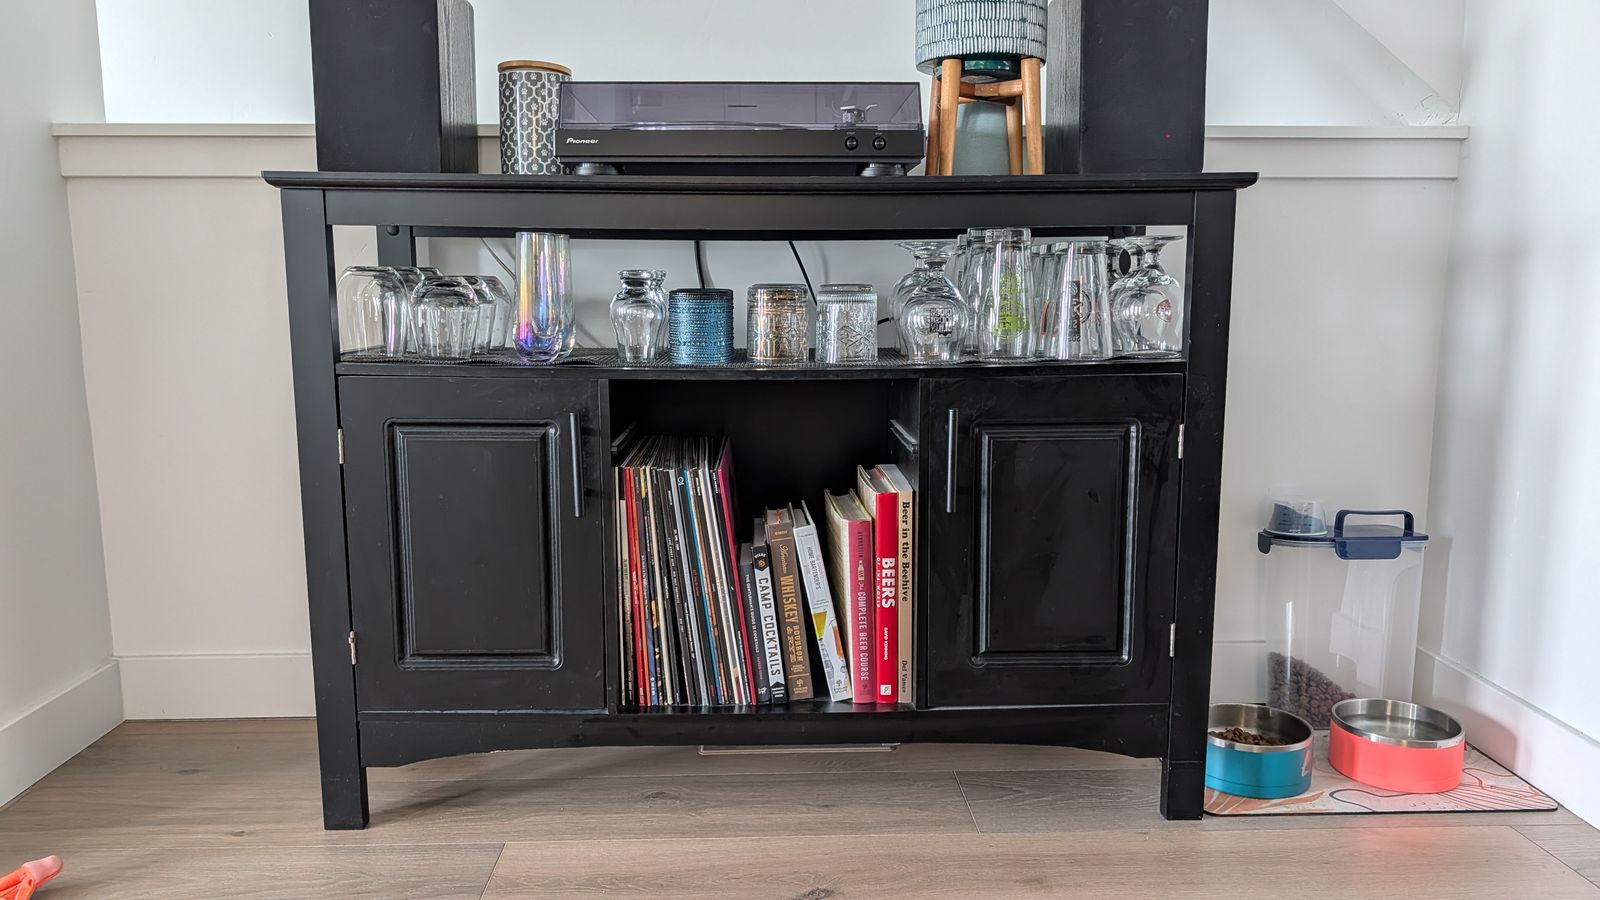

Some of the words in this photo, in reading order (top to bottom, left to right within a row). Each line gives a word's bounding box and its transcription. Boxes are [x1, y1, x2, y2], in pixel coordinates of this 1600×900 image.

[902, 501, 910, 525] Beer
[902, 528, 910, 539] in
[902, 542, 910, 559] the
[758, 577, 772, 609] CAMP
[882, 557, 896, 608] BEERS
[901, 561, 910, 602] Beehive
[780, 575, 799, 623] WHISKEY
[857, 591, 867, 630] COMPLETE
[763, 615, 781, 676] COCKTAILS
[793, 625, 804, 662] BOURBON
[859, 632, 868, 651] BEER
[860, 652, 869, 681] COURSE
